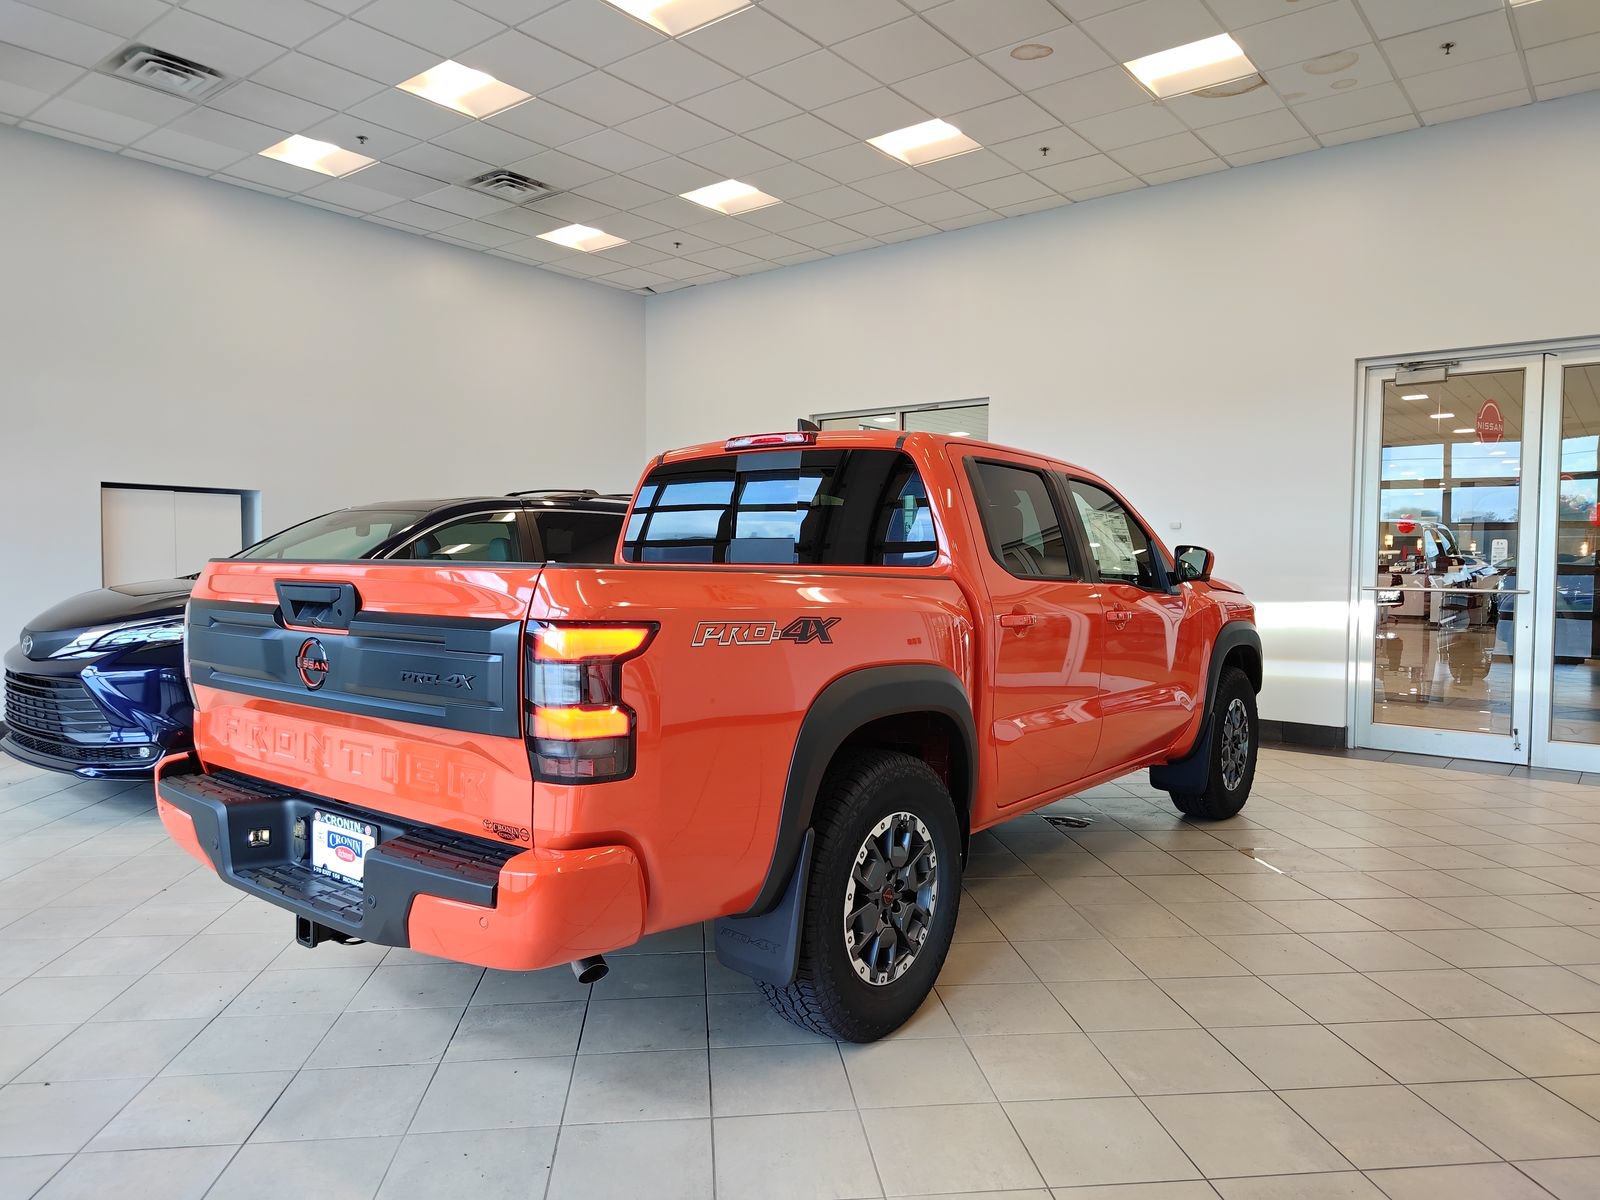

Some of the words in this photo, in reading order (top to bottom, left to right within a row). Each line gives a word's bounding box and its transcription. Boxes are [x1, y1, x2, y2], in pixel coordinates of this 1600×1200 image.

[1477, 421, 1503, 432] NISSAN
[691, 616, 842, 647] PRO-4X
[297, 656, 329, 672] SSAN
[401, 669, 477, 691] PRO-4X
[225, 719, 488, 801] FRONTIER
[325, 814, 361, 833] CRONIN
[329, 833, 361, 855] CRONIN
